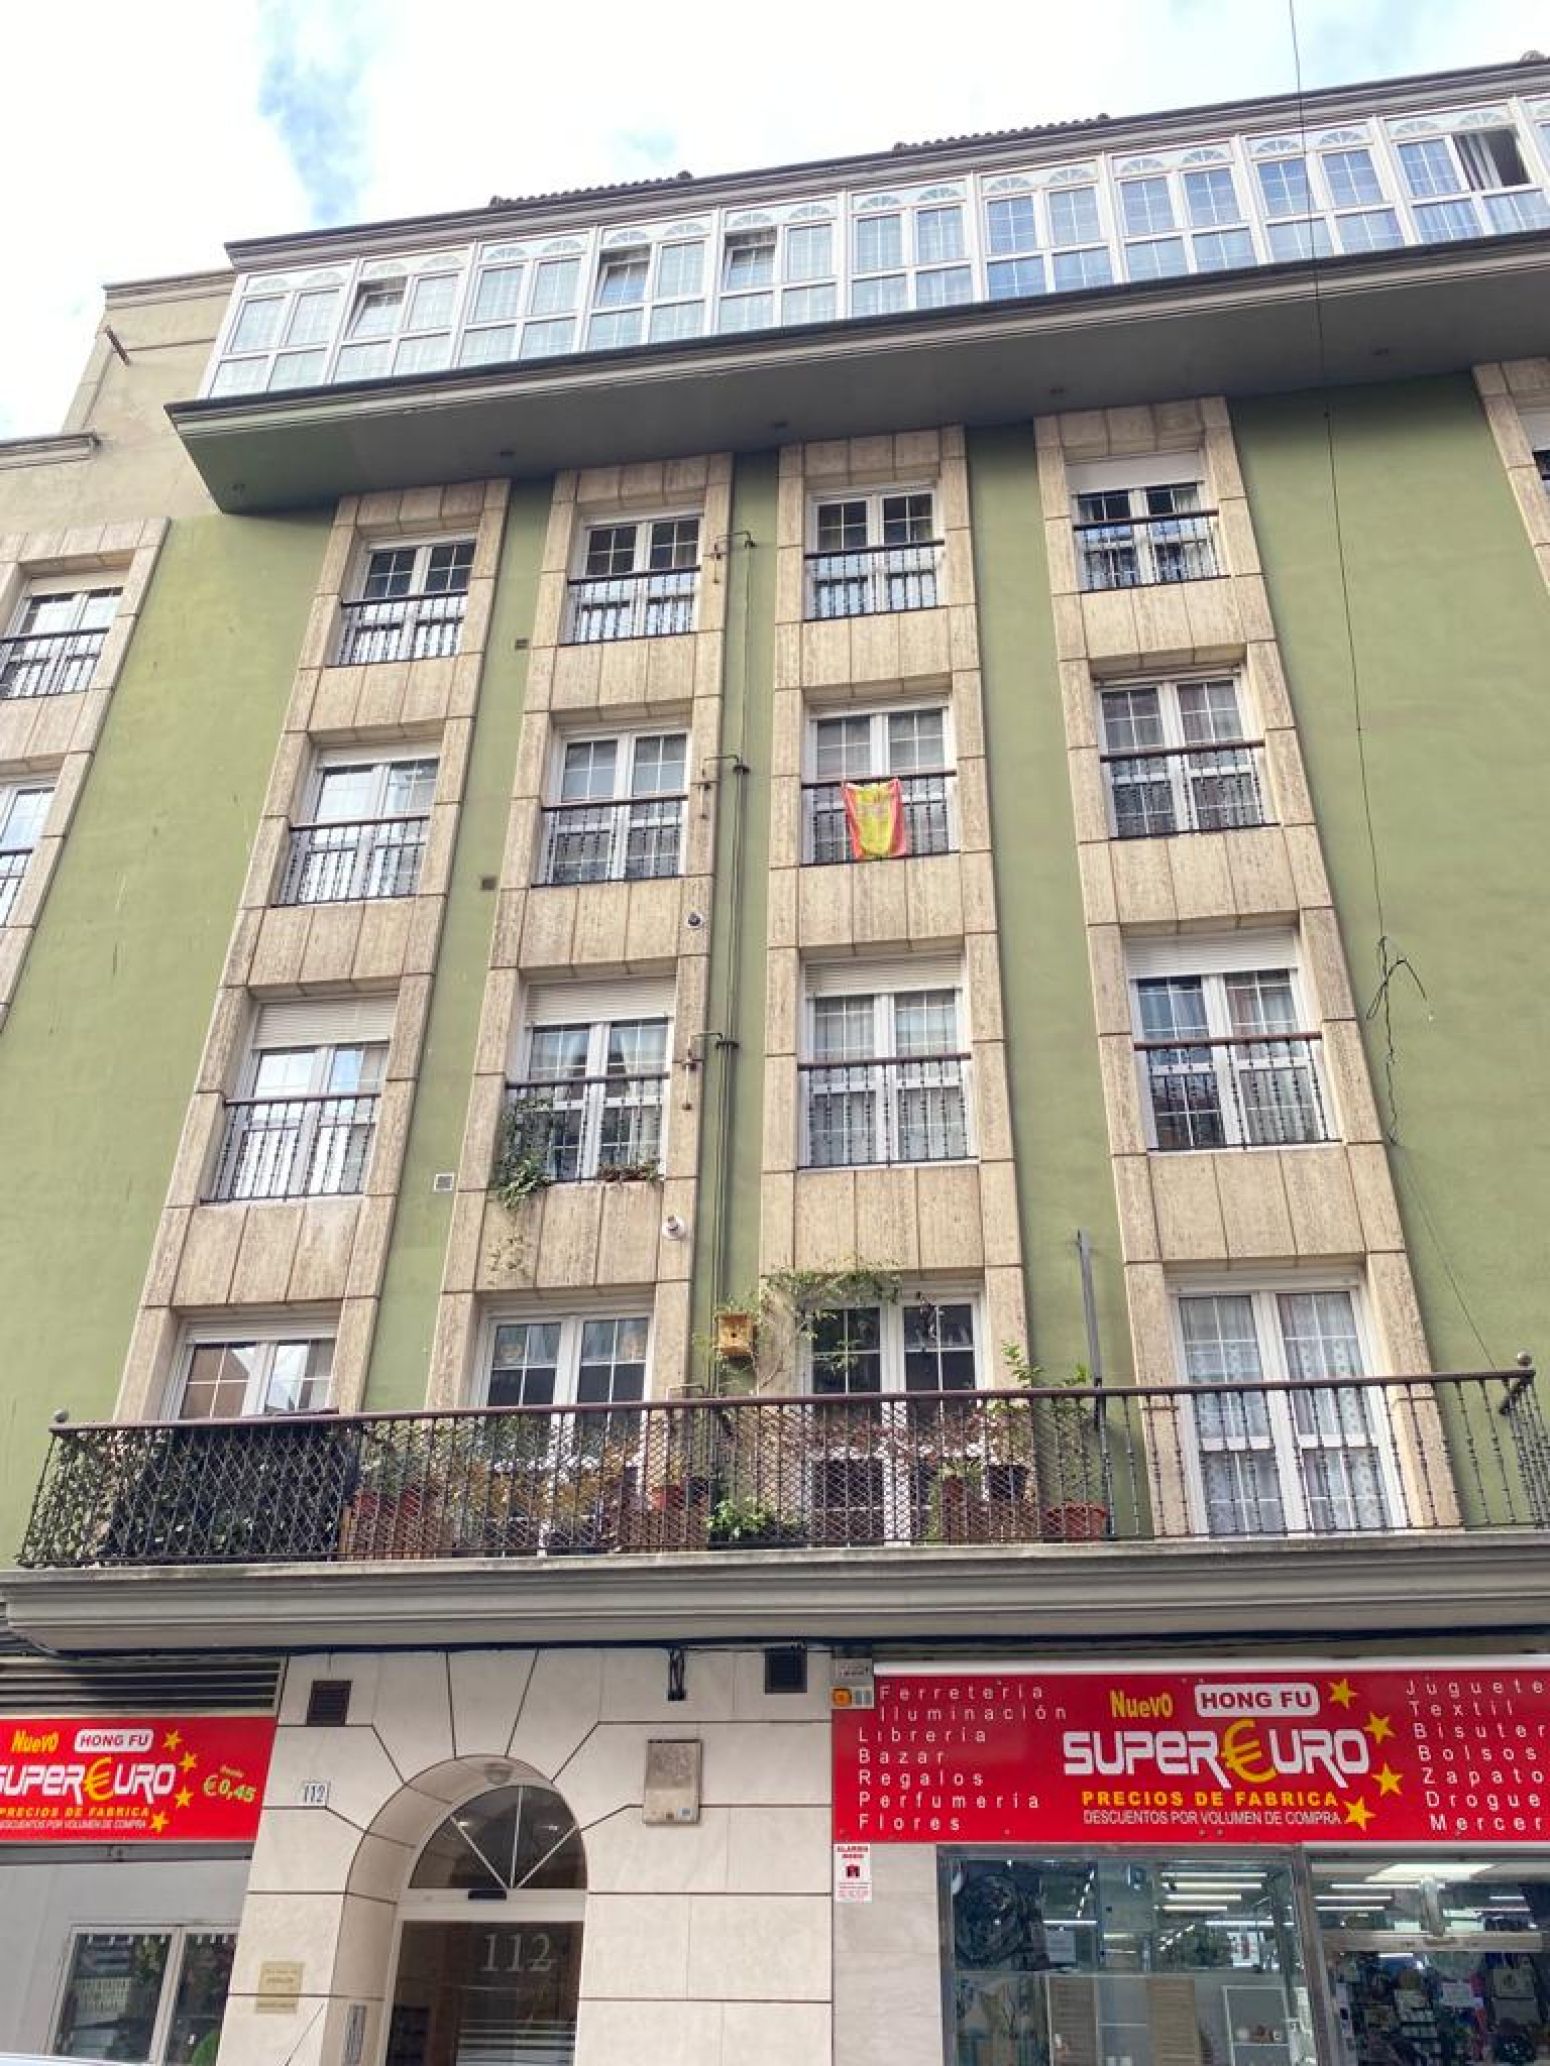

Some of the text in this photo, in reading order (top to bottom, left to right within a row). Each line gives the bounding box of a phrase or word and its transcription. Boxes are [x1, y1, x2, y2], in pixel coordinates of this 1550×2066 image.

[1110, 1689, 1173, 1718] Nuevo
[1201, 1691, 1313, 1709] HONG FU
[1409, 1700, 1513, 1718] Textil
[79, 1734, 150, 1748] HONG FU
[858, 1726, 986, 1742] Libreria
[858, 1748, 944, 1764] Bazar
[1418, 1745, 1537, 1762] Bolsos
[858, 1769, 984, 1791] Regalos
[304, 1784, 325, 1803] 112
[858, 1791, 1040, 1808] Perfumeria
[1081, 1790, 1338, 1807] PRECIOS DE FABRICA
[65, 1806, 84, 1818] DE
[87, 1806, 149, 1818] FABRICA
[1083, 1809, 1341, 1825] DESCUENTOS POR VOLUMEN DE COMPRA
[858, 1813, 960, 1831] Flores
[479, 1933, 554, 1972] 112
